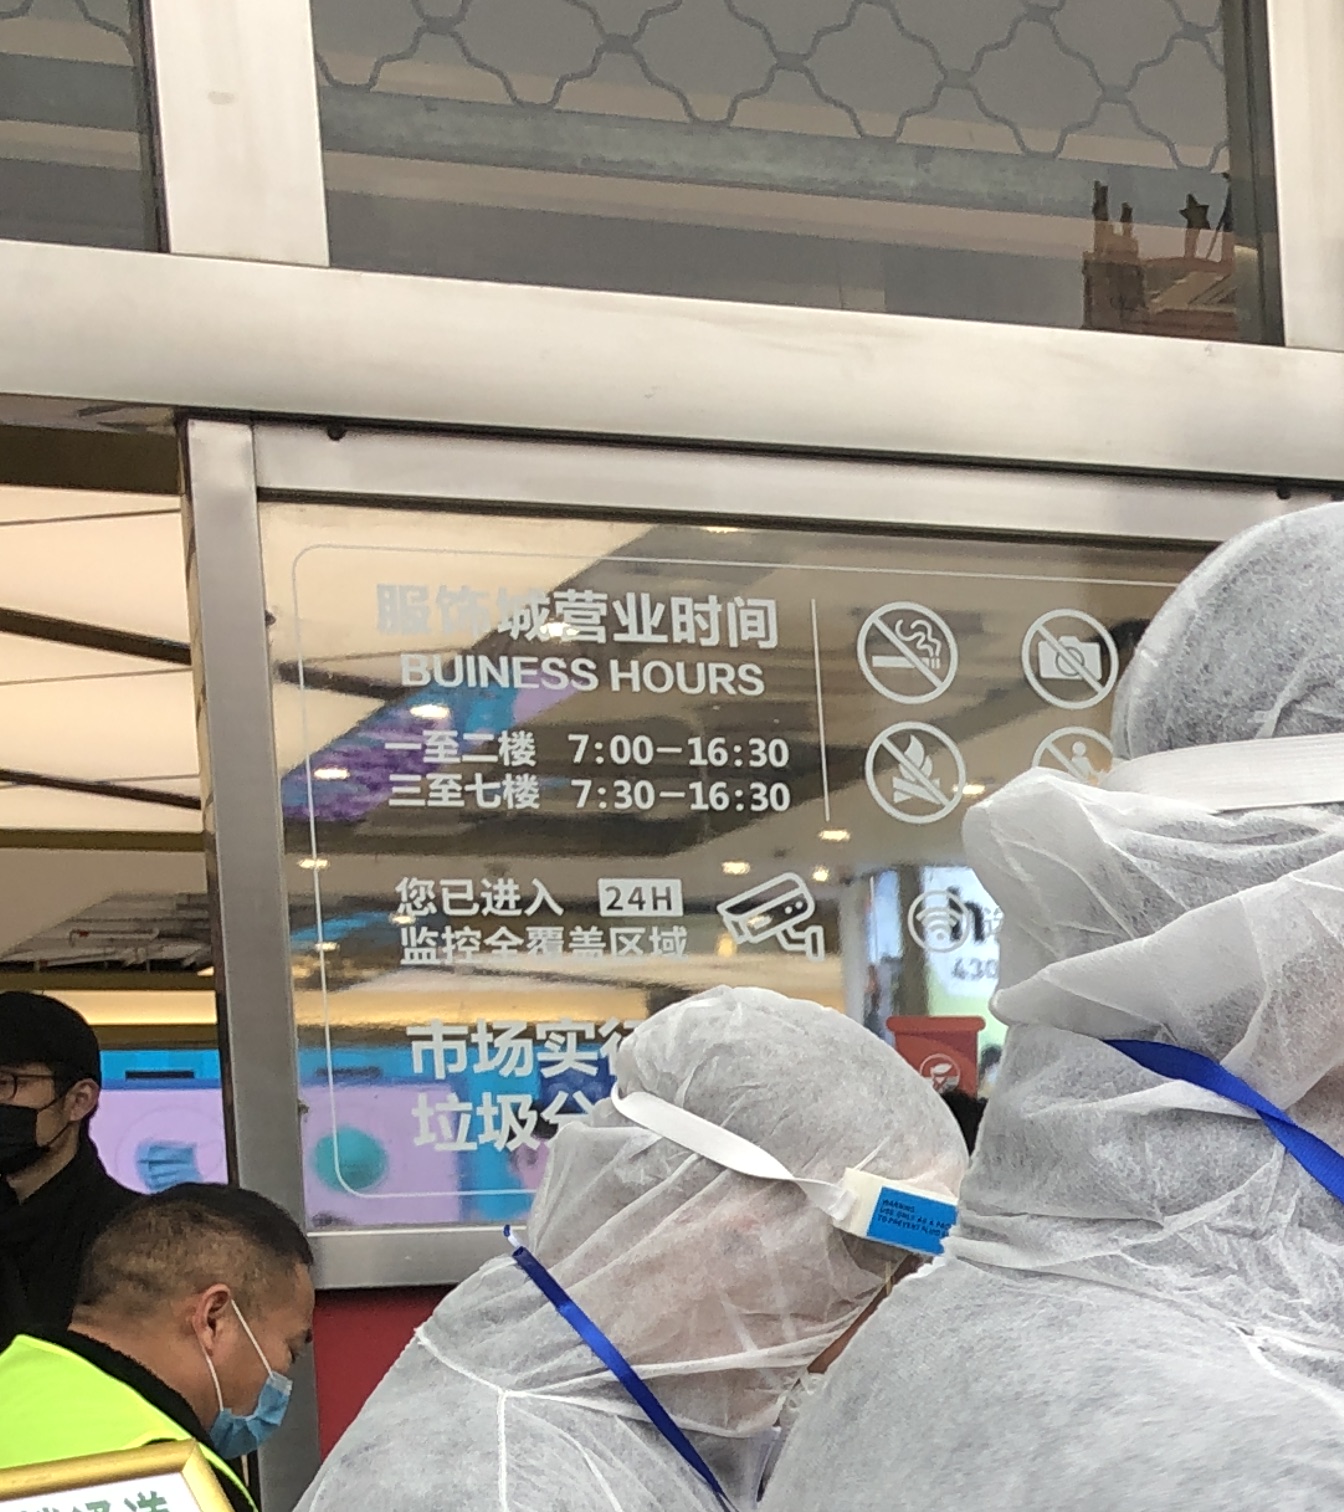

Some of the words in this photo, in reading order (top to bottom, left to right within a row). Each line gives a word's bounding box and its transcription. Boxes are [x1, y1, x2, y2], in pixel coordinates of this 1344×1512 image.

[376, 582, 780, 650] 服饰城营业时间
[400, 653, 599, 692] BUINESS
[610, 659, 766, 697] HOURS
[384, 729, 537, 768] 一至二楼
[388, 773, 540, 811] 三至七楼
[394, 876, 565, 917] 您已进入
[604, 885, 674, 912] 24H
[400, 925, 690, 965] 监控全覆盖区域
